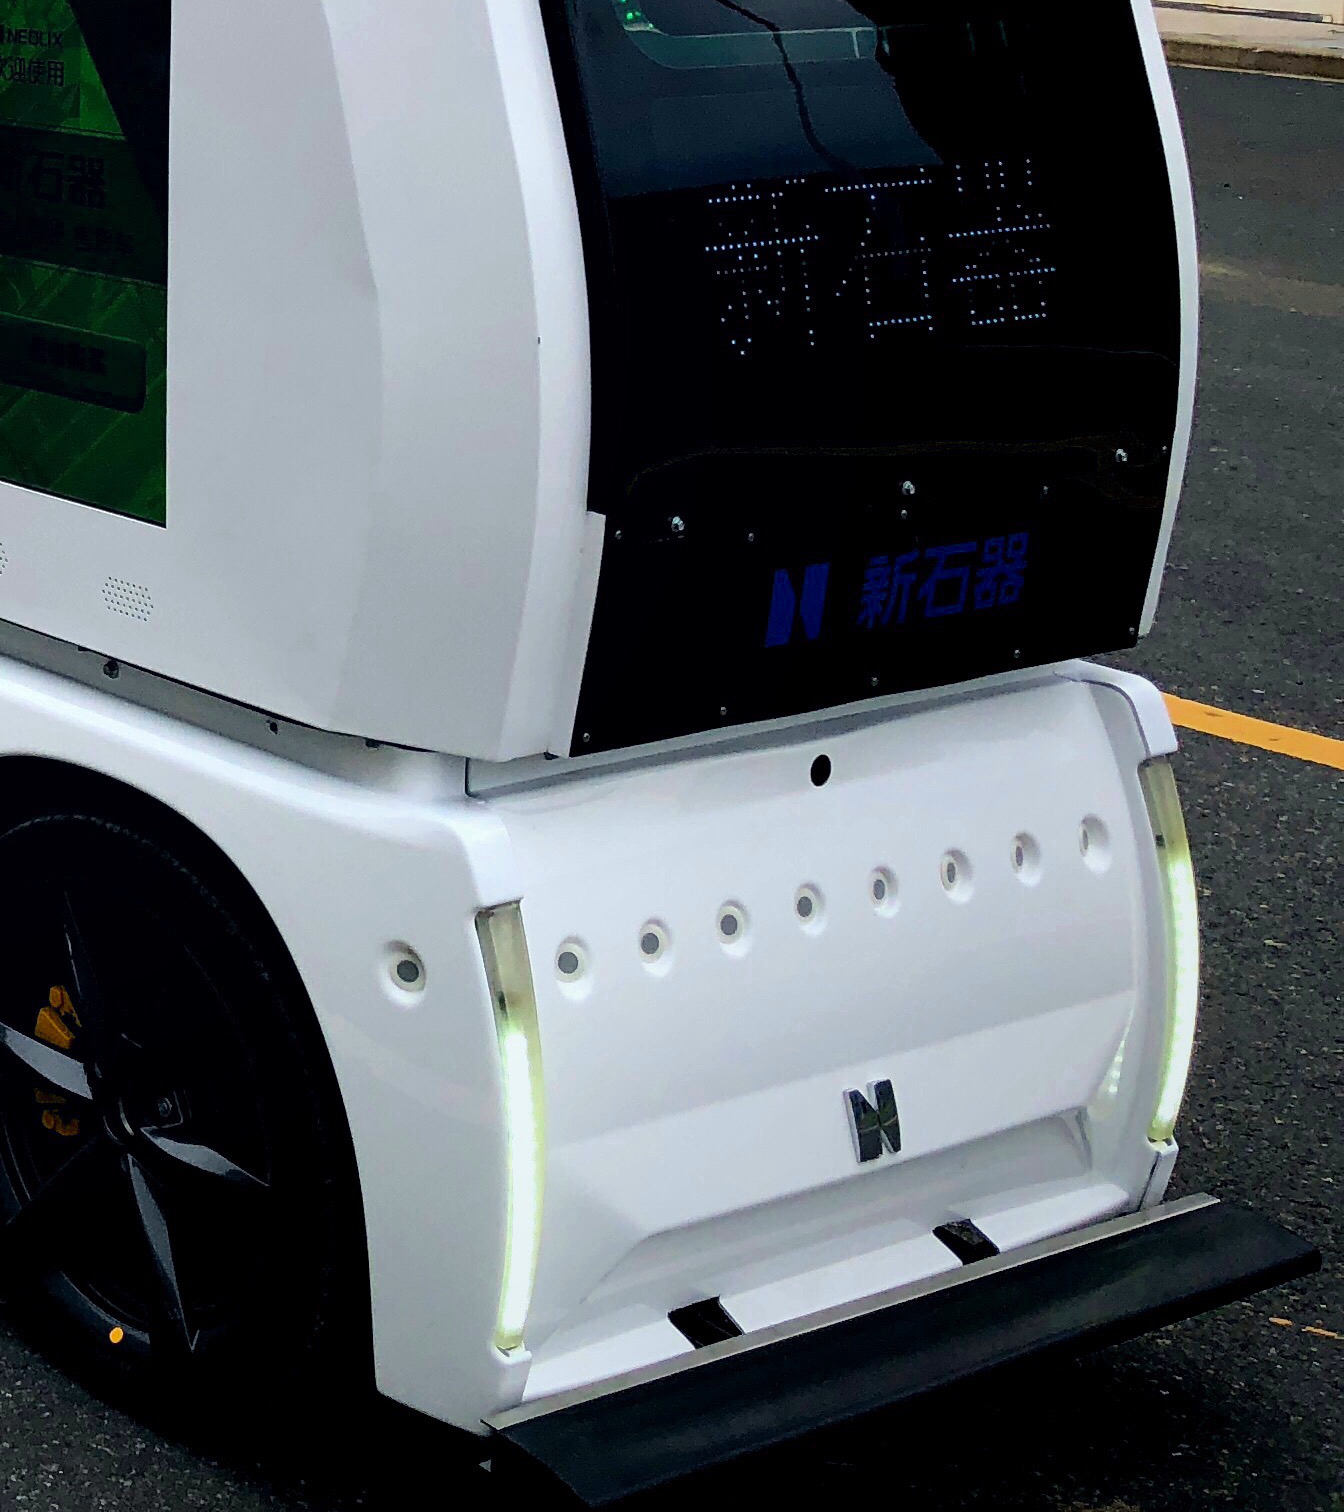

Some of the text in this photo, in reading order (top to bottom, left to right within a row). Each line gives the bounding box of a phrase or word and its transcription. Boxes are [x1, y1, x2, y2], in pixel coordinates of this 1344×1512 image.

[7, 28, 64, 48] NEOLIX
[857, 531, 1029, 629] 新石器
